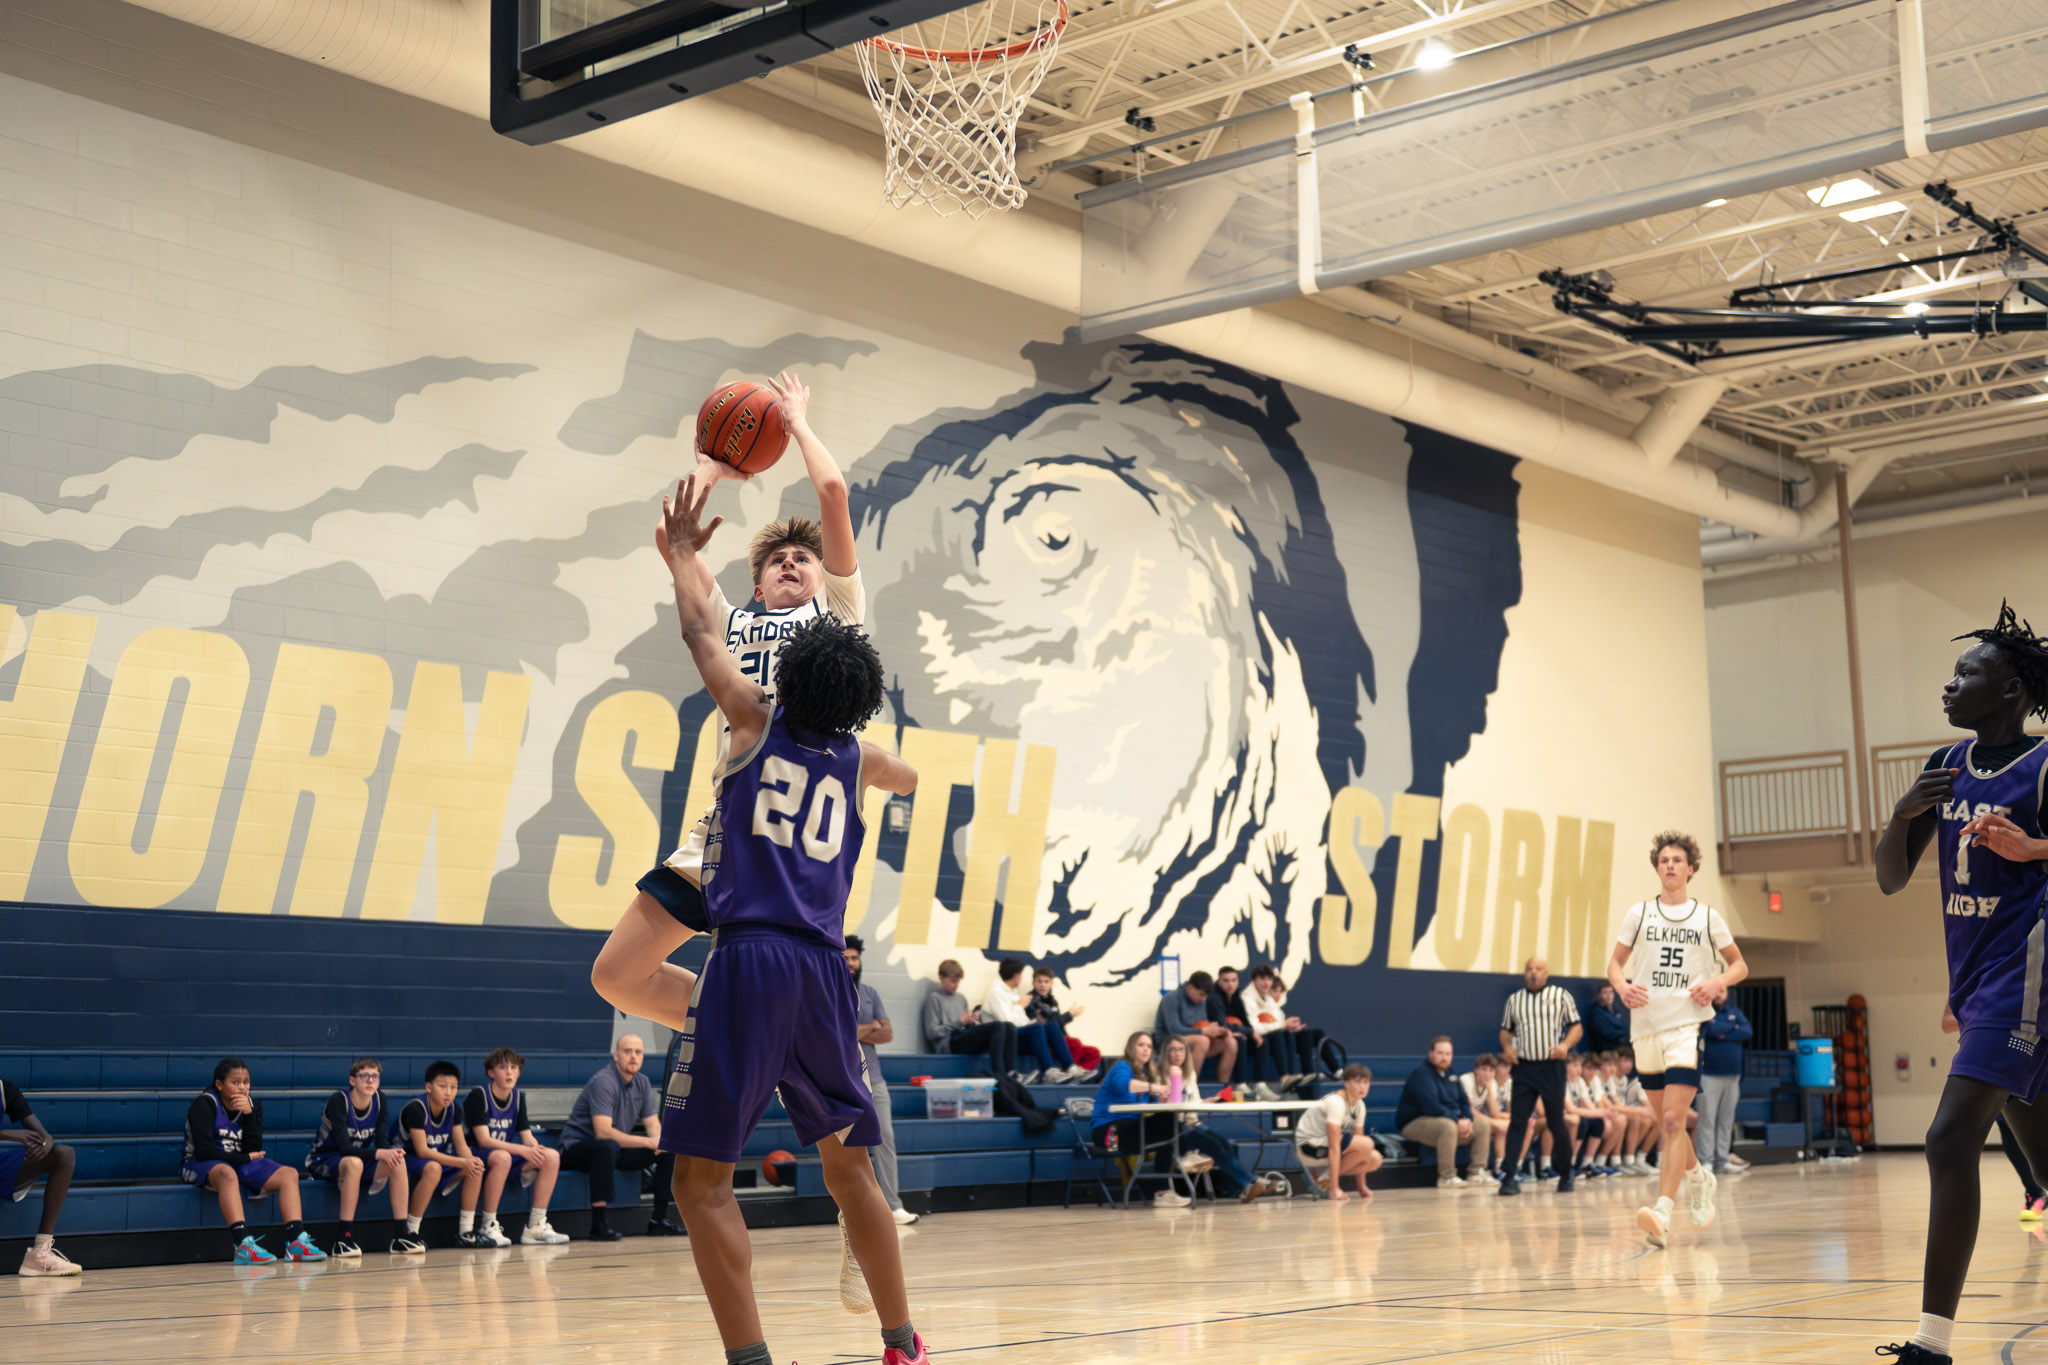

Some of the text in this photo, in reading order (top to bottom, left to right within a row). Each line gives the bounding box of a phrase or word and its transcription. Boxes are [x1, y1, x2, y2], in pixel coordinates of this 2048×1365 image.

[752, 754, 847, 864] 20
[1318, 786, 1616, 978] STORM
[1646, 926, 1702, 946] ELKHORN
[1659, 946, 1684, 968] 35
[1652, 971, 1689, 989] SOUTH
